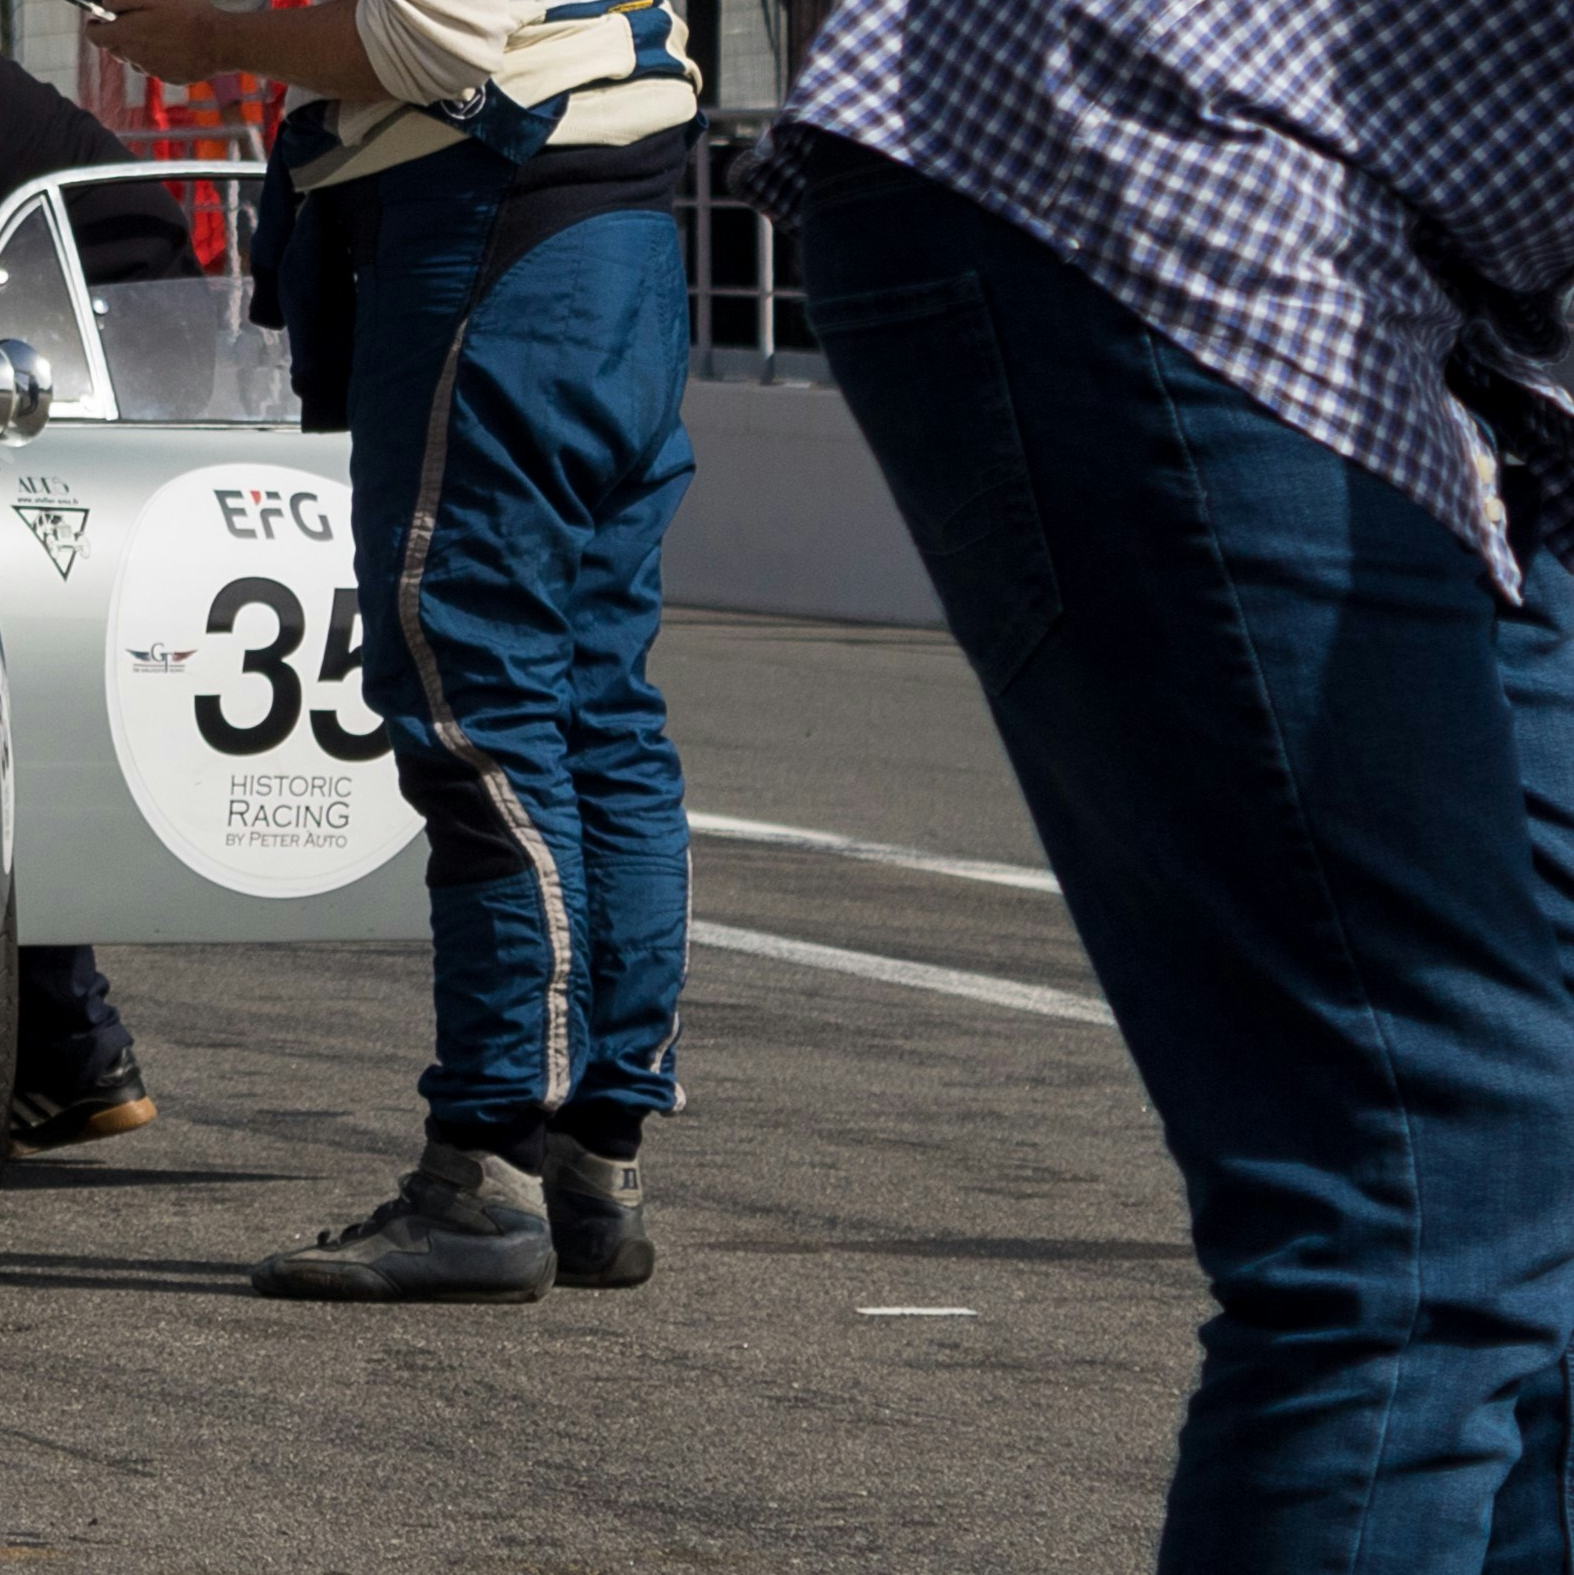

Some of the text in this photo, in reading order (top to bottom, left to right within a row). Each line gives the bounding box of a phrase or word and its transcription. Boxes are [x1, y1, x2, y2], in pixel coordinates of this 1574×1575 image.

[213, 489, 334, 542] EFG
[194, 576, 394, 763] 35
[230, 774, 352, 798] HISTORIC
[227, 799, 350, 829] RACING
[225, 831, 348, 849] BY PETER AUTO
